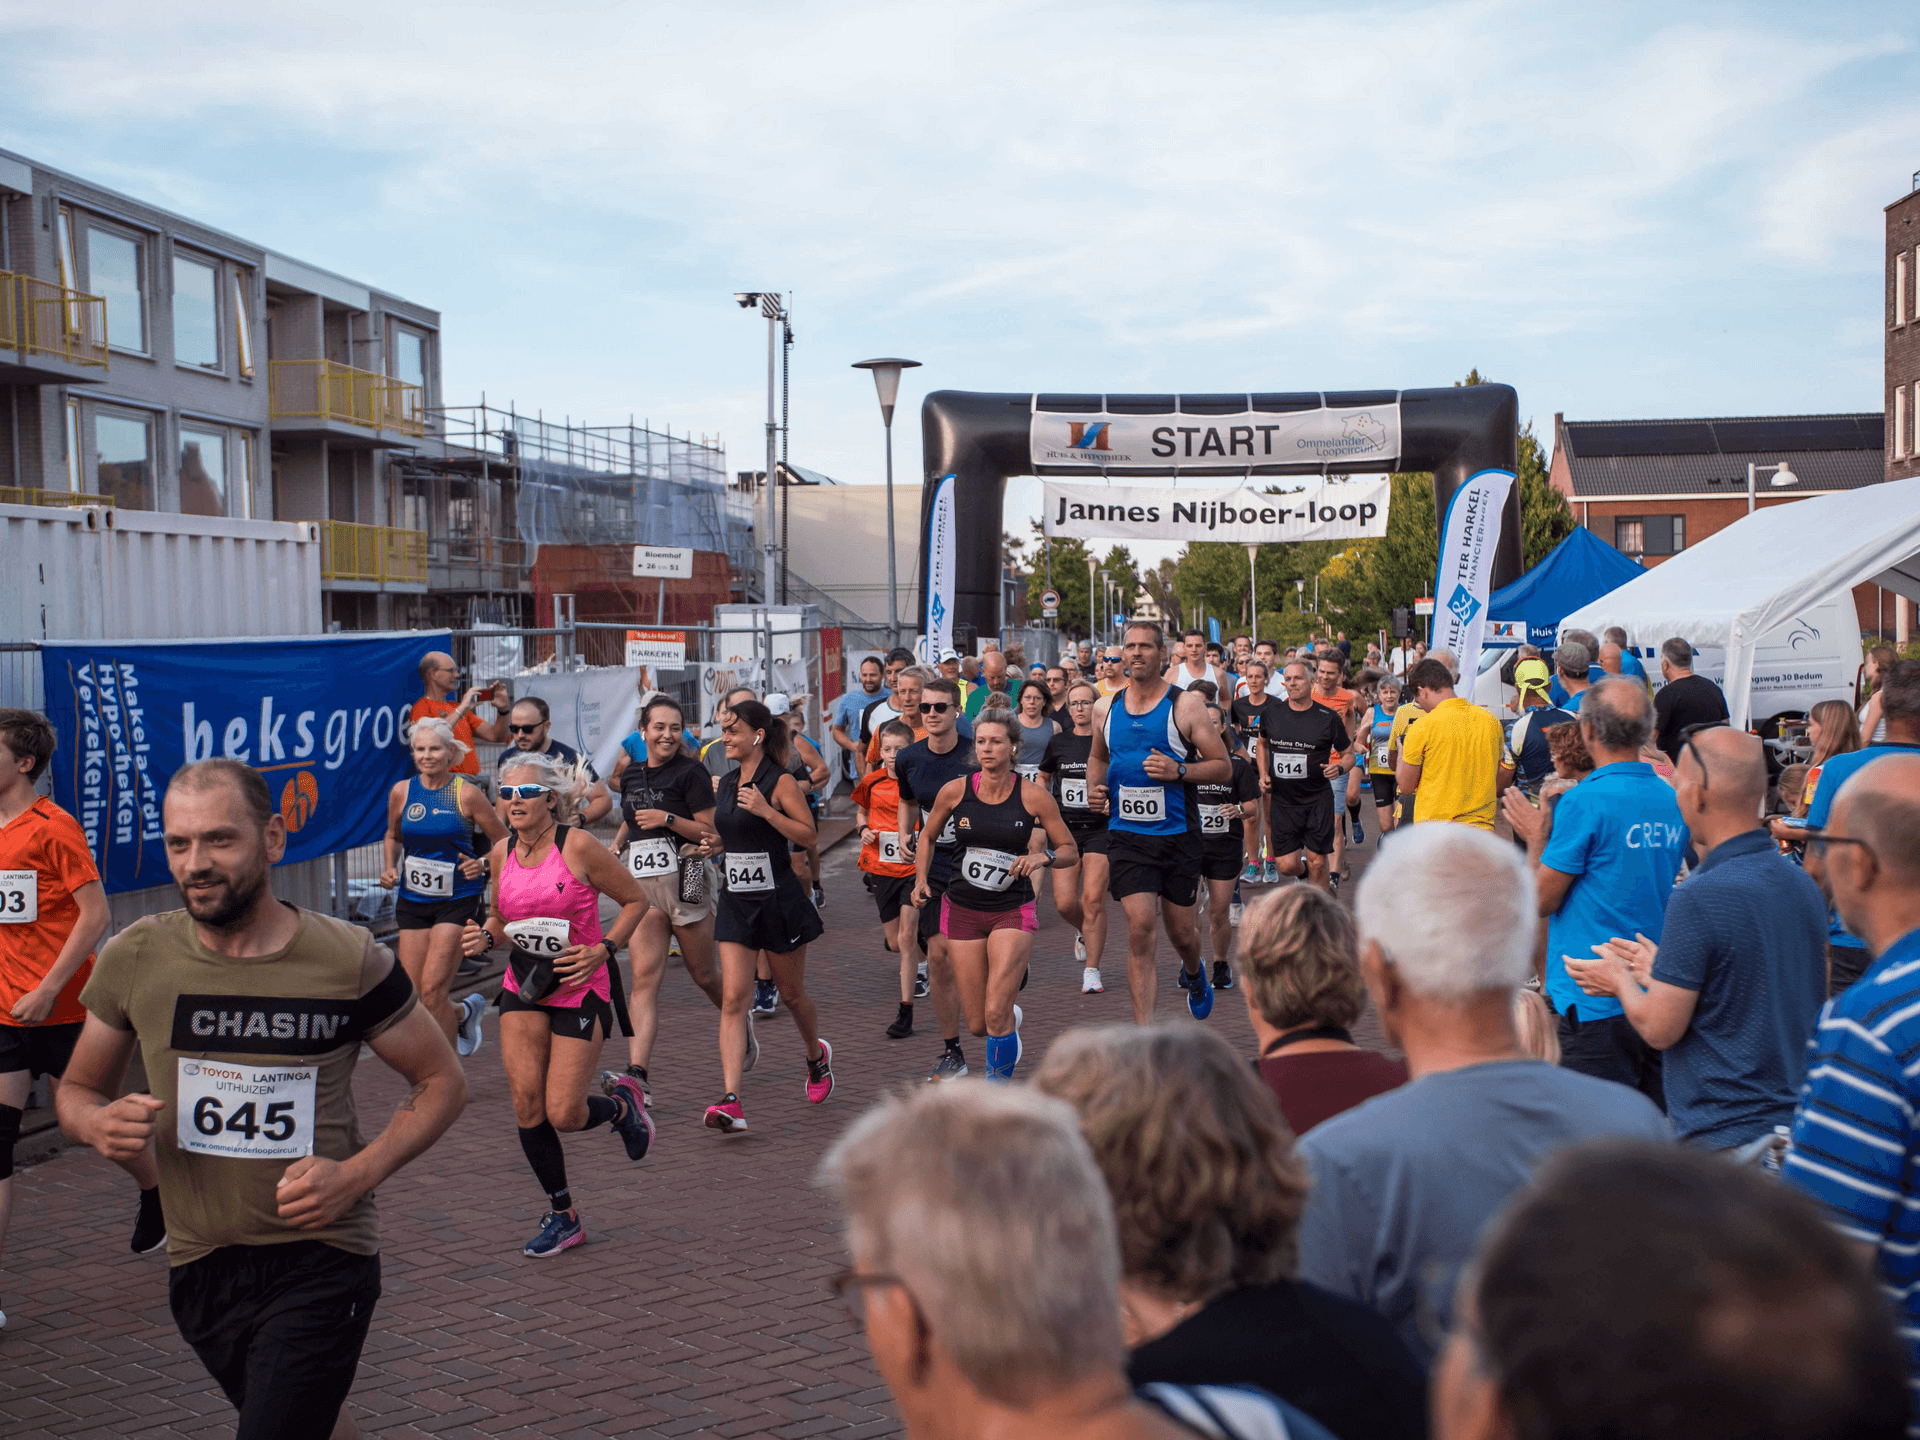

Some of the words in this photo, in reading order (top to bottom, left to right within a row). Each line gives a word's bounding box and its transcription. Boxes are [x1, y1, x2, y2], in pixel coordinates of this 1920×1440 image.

[1151, 425, 1280, 458] START
[1296, 437, 1366, 449] Ommelander
[1080, 453, 1132, 461] HYPOTHEEK
[1316, 444, 1374, 457] Loopcircuit
[1055, 497, 1160, 526] Jannes
[1172, 501, 1377, 531] Nijboer-loop
[1463, 488, 1481, 548] HARKEL
[1467, 490, 1490, 592] FINANCIERINGEN
[1457, 553, 1470, 581] TER
[1448, 619, 1461, 647] ILLE
[1531, 627, 1552, 637] Huis
[632, 649, 680, 658] PARKEREN
[1794, 672, 1823, 681] Bedum
[99, 664, 134, 844] Hypotheken
[119, 664, 164, 840] Makelaardij
[1277, 762, 1302, 774] 614
[1065, 789, 1084, 803] 61
[1122, 799, 1159, 815] 660
[1202, 815, 1225, 828] 29
[1626, 822, 1683, 848] CREW
[633, 852, 670, 871] 643
[980, 855, 1005, 865] UITHUIZEN
[995, 853, 1016, 862] LANTING
[410, 870, 444, 890] 631
[729, 866, 766, 884] 644
[968, 861, 1010, 885] 677
[521, 925, 550, 933] UITHUIZEN
[538, 920, 567, 928] LANTINGA
[513, 933, 563, 953] 676
[190, 1009, 350, 1040] CHASIN'
[202, 1066, 243, 1081] TOYOTA
[253, 1071, 312, 1083] LANTINGA
[216, 1080, 275, 1095] UITHUIZEN
[193, 1095, 297, 1142] 645
